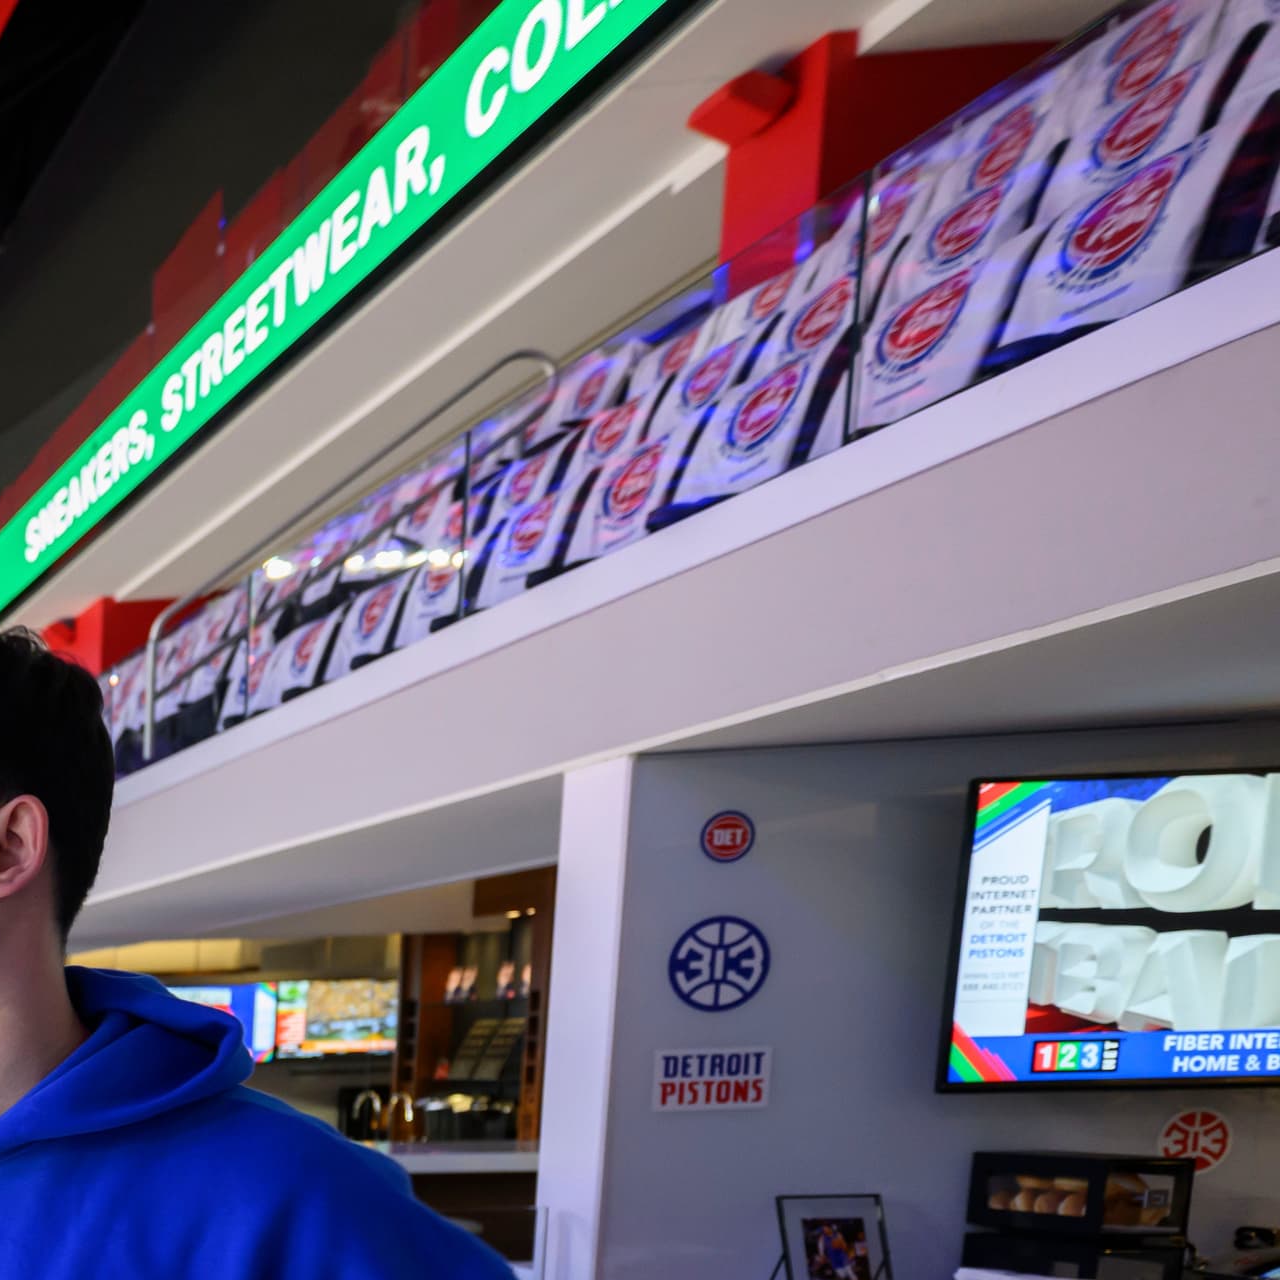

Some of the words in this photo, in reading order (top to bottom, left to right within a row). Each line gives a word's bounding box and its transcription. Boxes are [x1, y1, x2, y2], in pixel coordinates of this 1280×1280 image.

[24, 409, 155, 562] SNEAKERS,
[160, 124, 446, 433] STREETWEAR,
[464, 0, 624, 138] COL
[712, 827, 744, 846] DET
[981, 875, 1029, 885] PROUD
[971, 904, 1032, 914] PARTNER
[970, 932, 1027, 945] DETROIT
[968, 947, 1025, 959] PISTONS
[675, 932, 764, 996] 313
[1163, 1033, 1224, 1051] FIBER
[1229, 1032, 1280, 1050] INTE
[1039, 1043, 1100, 1069] 123
[1172, 1055, 1240, 1073] HOME
[1245, 1055, 1261, 1072] &
[662, 1052, 766, 1080] DETROIT
[659, 1078, 765, 1107] PISTONS
[1162, 1120, 1229, 1162] 313
